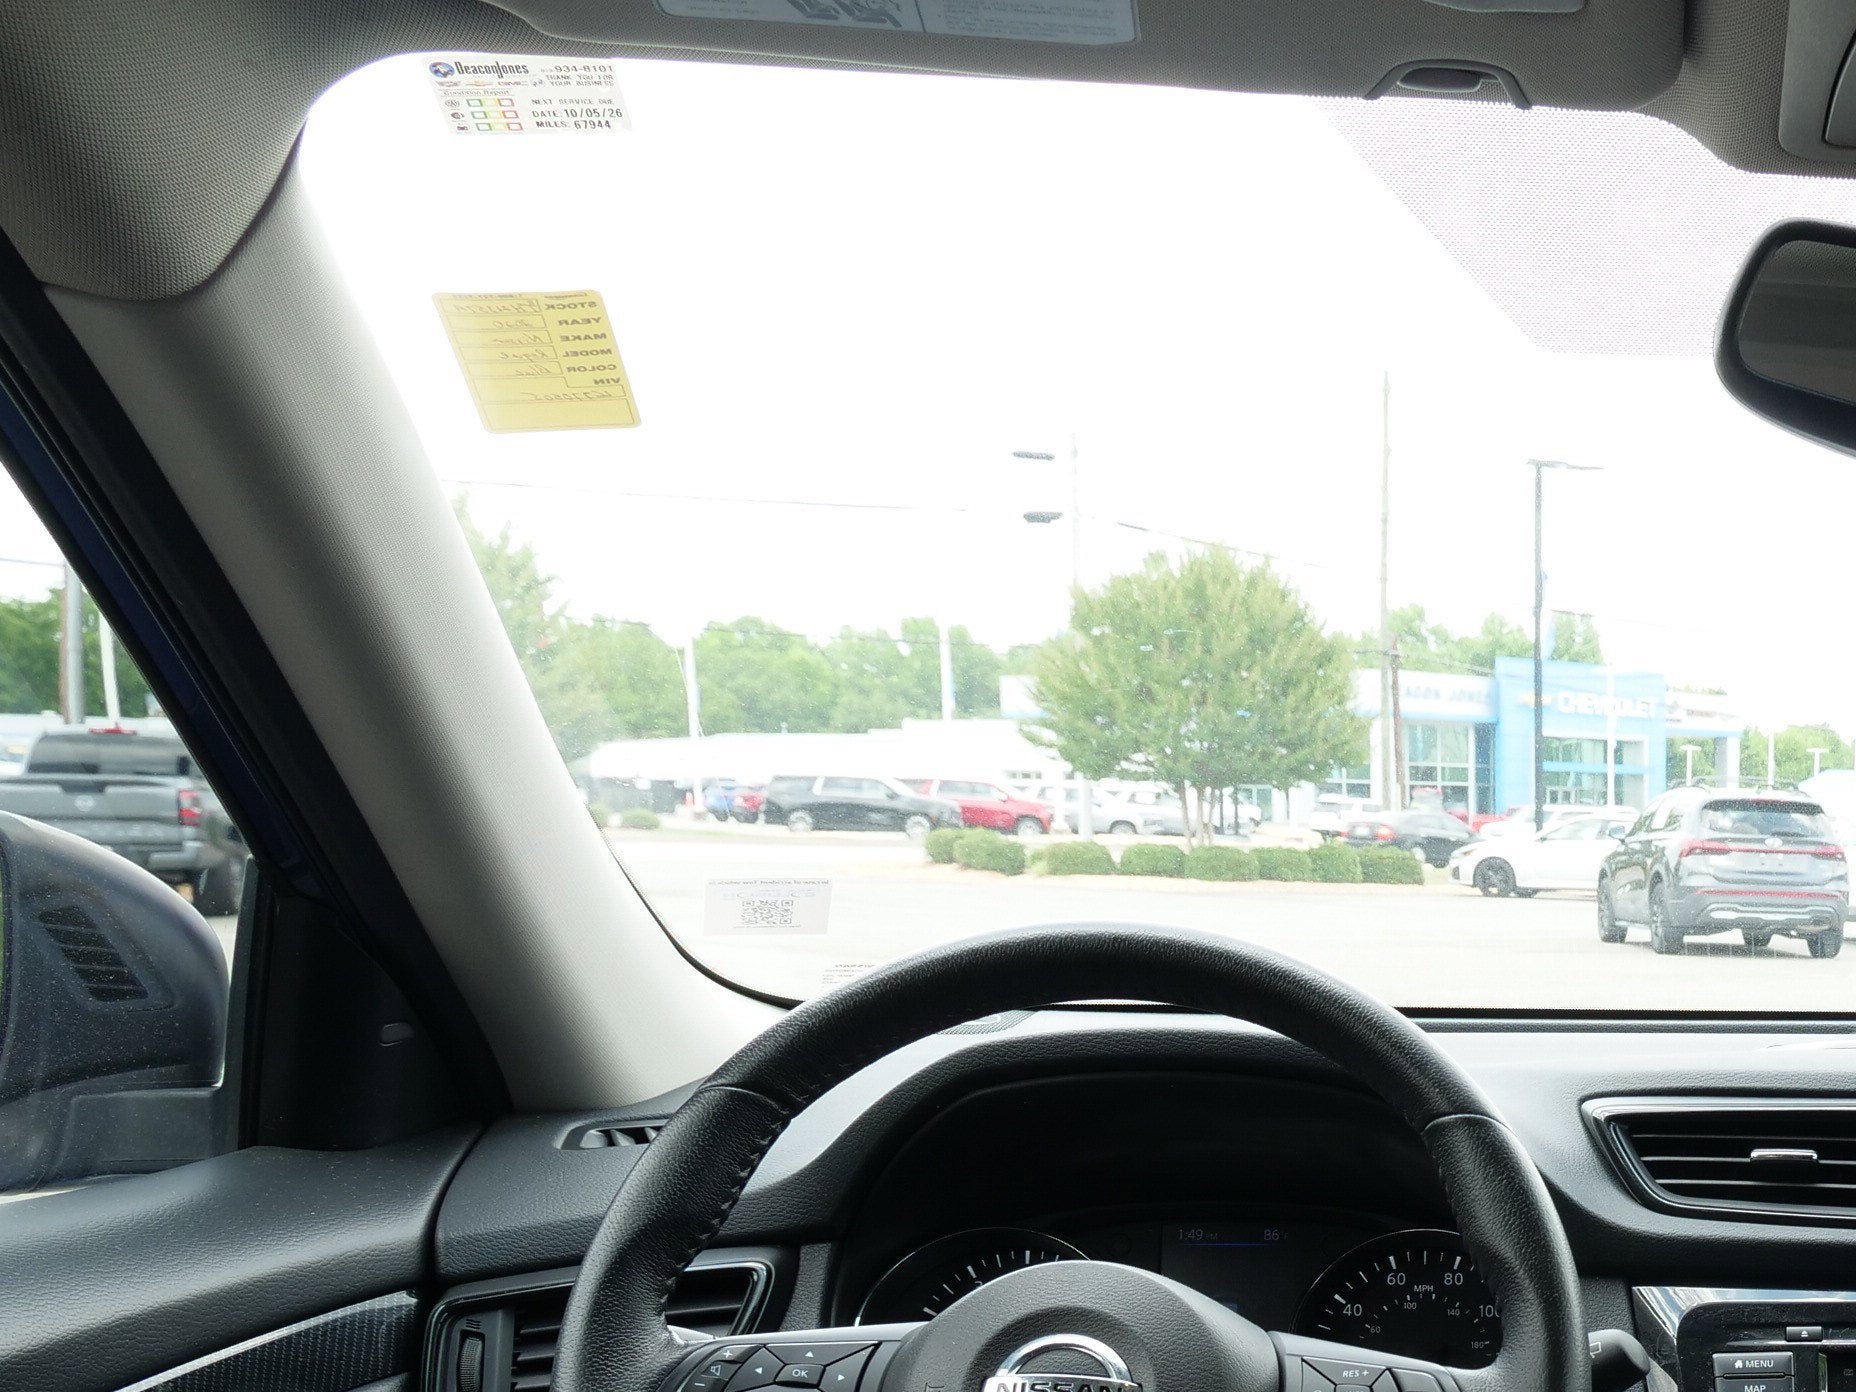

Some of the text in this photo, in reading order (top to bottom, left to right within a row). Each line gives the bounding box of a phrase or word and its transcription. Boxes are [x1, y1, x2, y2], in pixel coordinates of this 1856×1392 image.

[554, 65, 614, 73] 934-8101
[564, 108, 623, 118] 10/05/26
[574, 120, 611, 129] 67944
[1558, 692, 1657, 719] CHEVOLET
[1179, 1229, 1204, 1240] 1:49
[1386, 1272, 1406, 1286] 60
[1444, 1272, 1464, 1286] 80
[1413, 1284, 1434, 1293] MPH
[1342, 1303, 1363, 1317] 40
[1403, 1302, 1417, 1310] 100
[1446, 1308, 1460, 1317] 140
[1370, 1325, 1381, 1334] 60
[1471, 1340, 1484, 1349] 180
[1745, 1359, 1775, 1368] MENU
[792, 1369, 808, 1379] OK
[1342, 1369, 1360, 1378] RES
